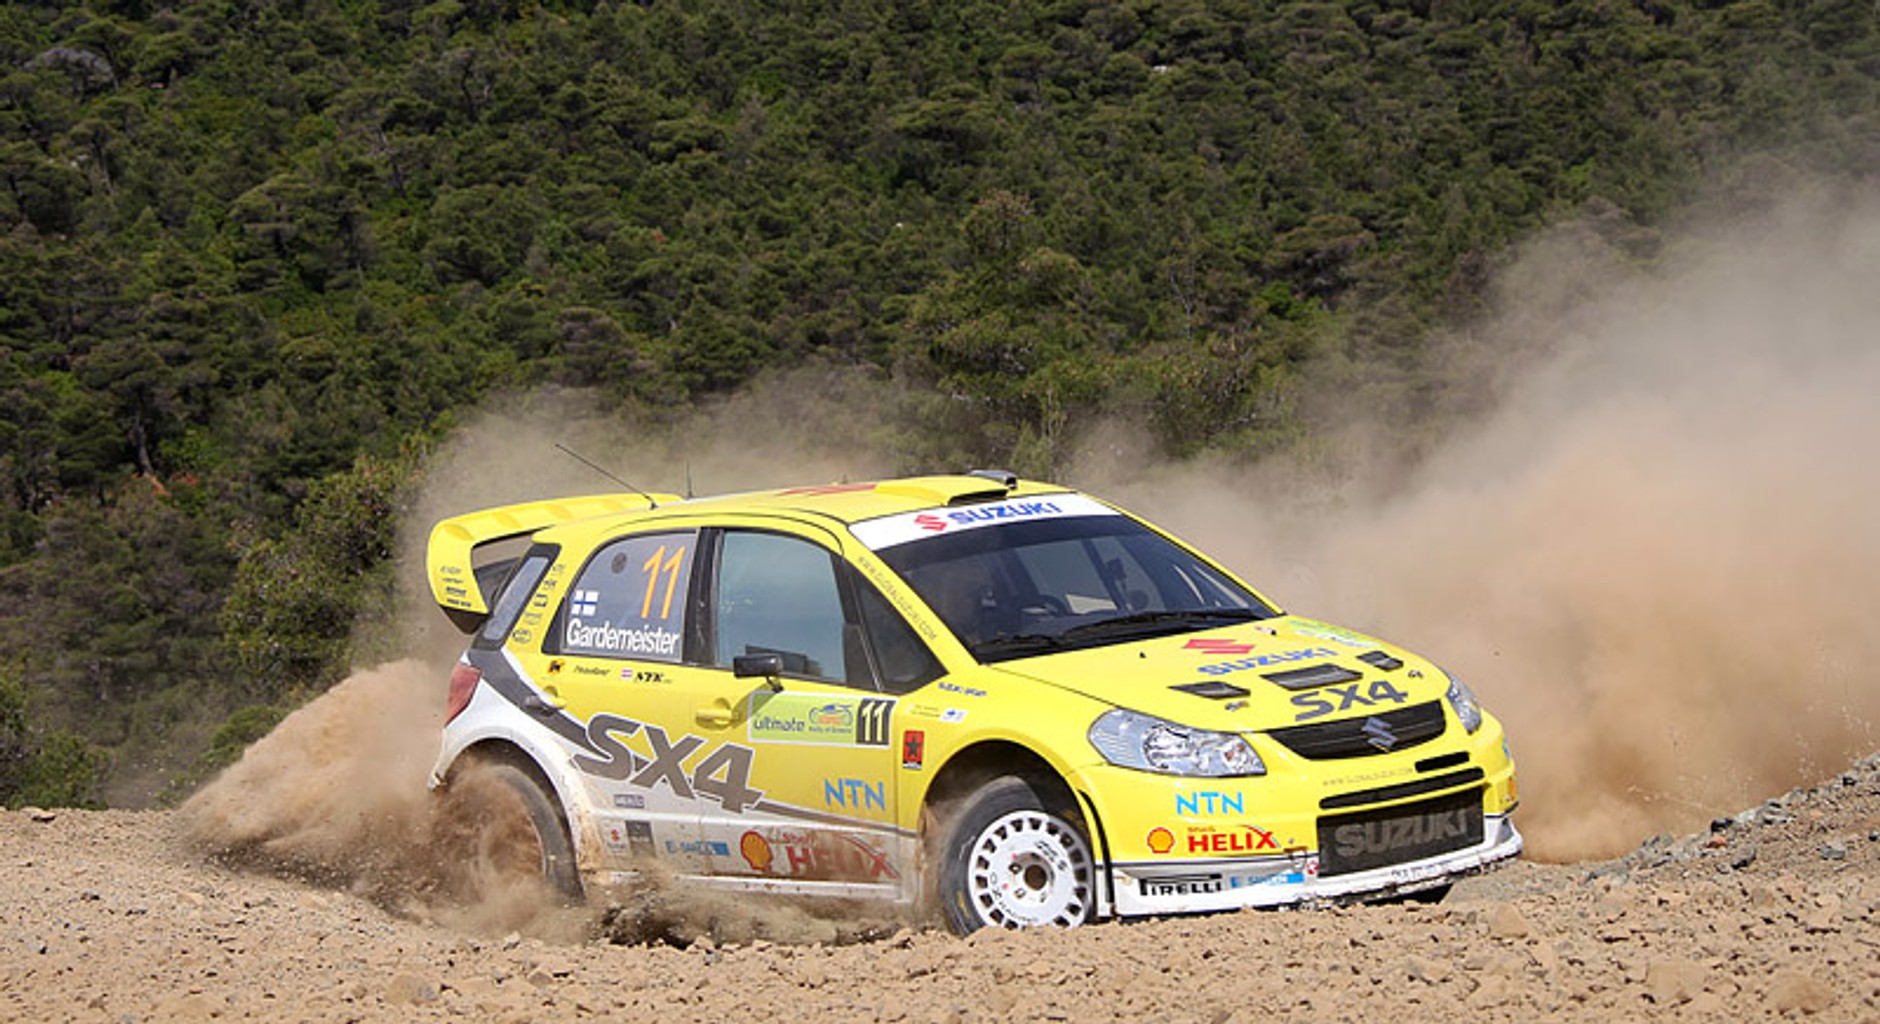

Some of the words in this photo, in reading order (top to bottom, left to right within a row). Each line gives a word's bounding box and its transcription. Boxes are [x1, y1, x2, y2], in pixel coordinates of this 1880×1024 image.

[948, 501, 1062, 525] SUZUKI
[642, 545, 686, 619] 11
[566, 618, 680, 654] Gardemeister
[1197, 647, 1339, 675] SUZUKI
[1290, 680, 1409, 722] SX4
[754, 713, 805, 732] ultimate
[862, 700, 888, 742] 11
[572, 714, 764, 813] SX4
[824, 778, 886, 810] NTN
[1176, 792, 1244, 815] NTN
[1188, 831, 1277, 853] HELIX
[1335, 809, 1468, 857] SUZUKI
[1139, 873, 1222, 896] PIRELLI
